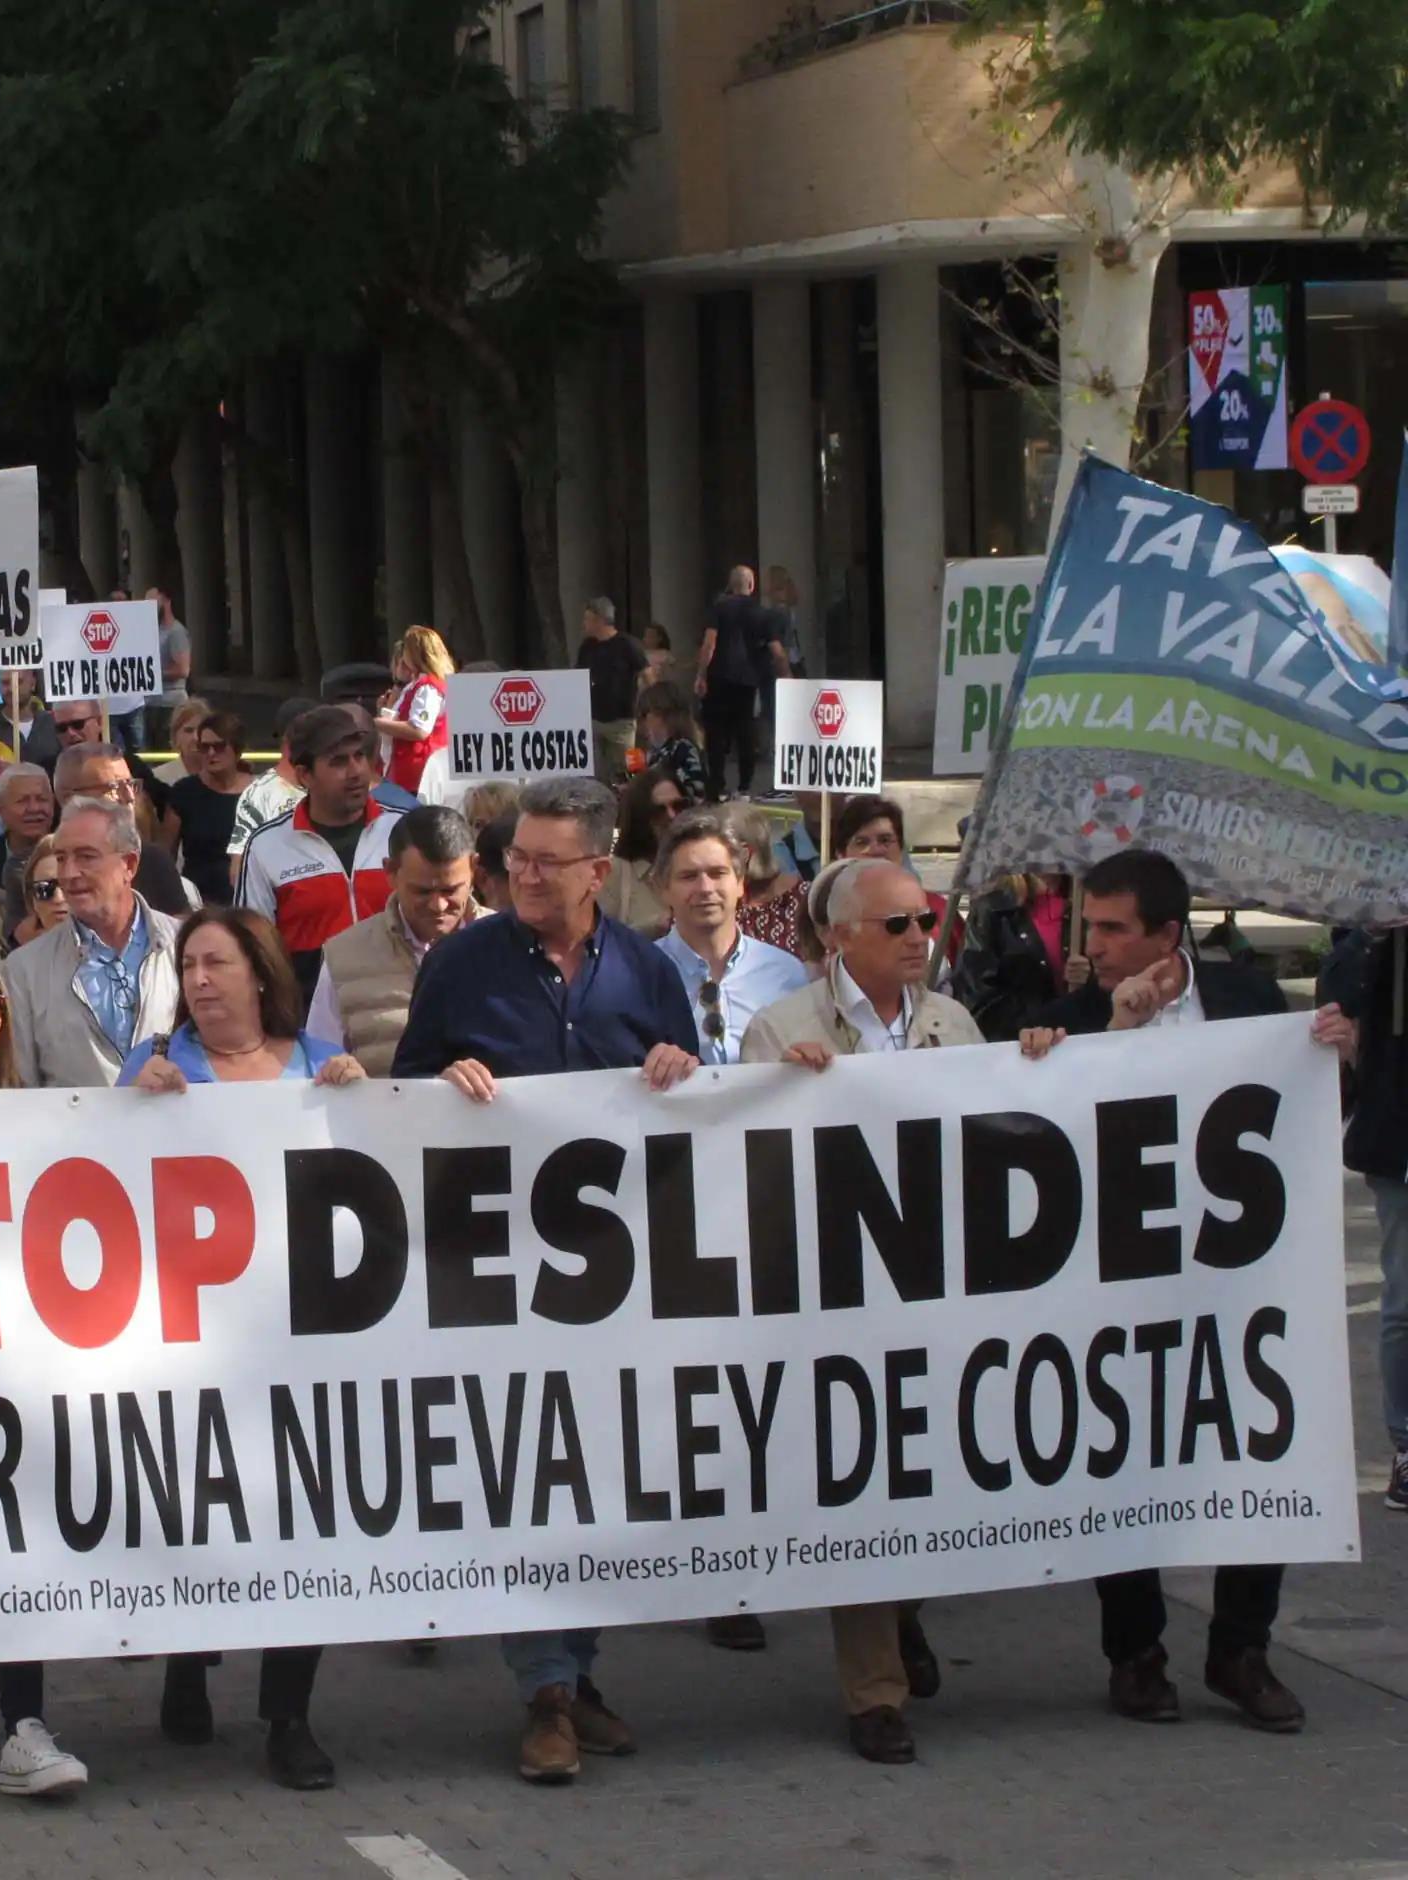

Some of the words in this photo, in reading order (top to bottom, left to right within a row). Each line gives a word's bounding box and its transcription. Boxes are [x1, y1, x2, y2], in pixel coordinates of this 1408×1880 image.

[1033, 584, 1122, 659] LA
[50, 660, 75, 697] LEY
[80, 658, 100, 695] DE
[499, 691, 538, 713] STOP
[453, 733, 484, 773] LEY
[491, 732, 515, 772] DE
[521, 729, 588, 771] COSTAS
[781, 744, 804, 786] LEY
[824, 744, 877, 788] COSTAS
[1083, 692, 1134, 735] LA
[1145, 697, 1317, 780] ARENA
[1331, 754, 1408, 796] NO
[279, 861, 325, 880] adidas
[284, 1083, 1287, 1337] DESLINDES
[52, 1387, 252, 1553] UNA
[270, 1369, 596, 1541] NUEVA
[620, 1360, 786, 1524] LEY
[814, 1347, 934, 1509] DE
[957, 1306, 1297, 1492] COSTAS
[89, 1578, 166, 1617] Playas
[173, 1575, 241, 1607] Norte
[247, 1571, 277, 1601] de
[283, 1567, 361, 1602] Dénia,
[368, 1558, 496, 1596] Asociación
[504, 1556, 570, 1595] playa
[578, 1543, 759, 1582] Deveses-Basot
[765, 1547, 778, 1576] y
[786, 1528, 918, 1566] Federación
[925, 1515, 1073, 1553] asociaciones
[1079, 1505, 1107, 1536] de
[1112, 1496, 1197, 1530] vecinos
[1203, 1489, 1234, 1520] de
[1241, 1487, 1322, 1520] Dénia.
